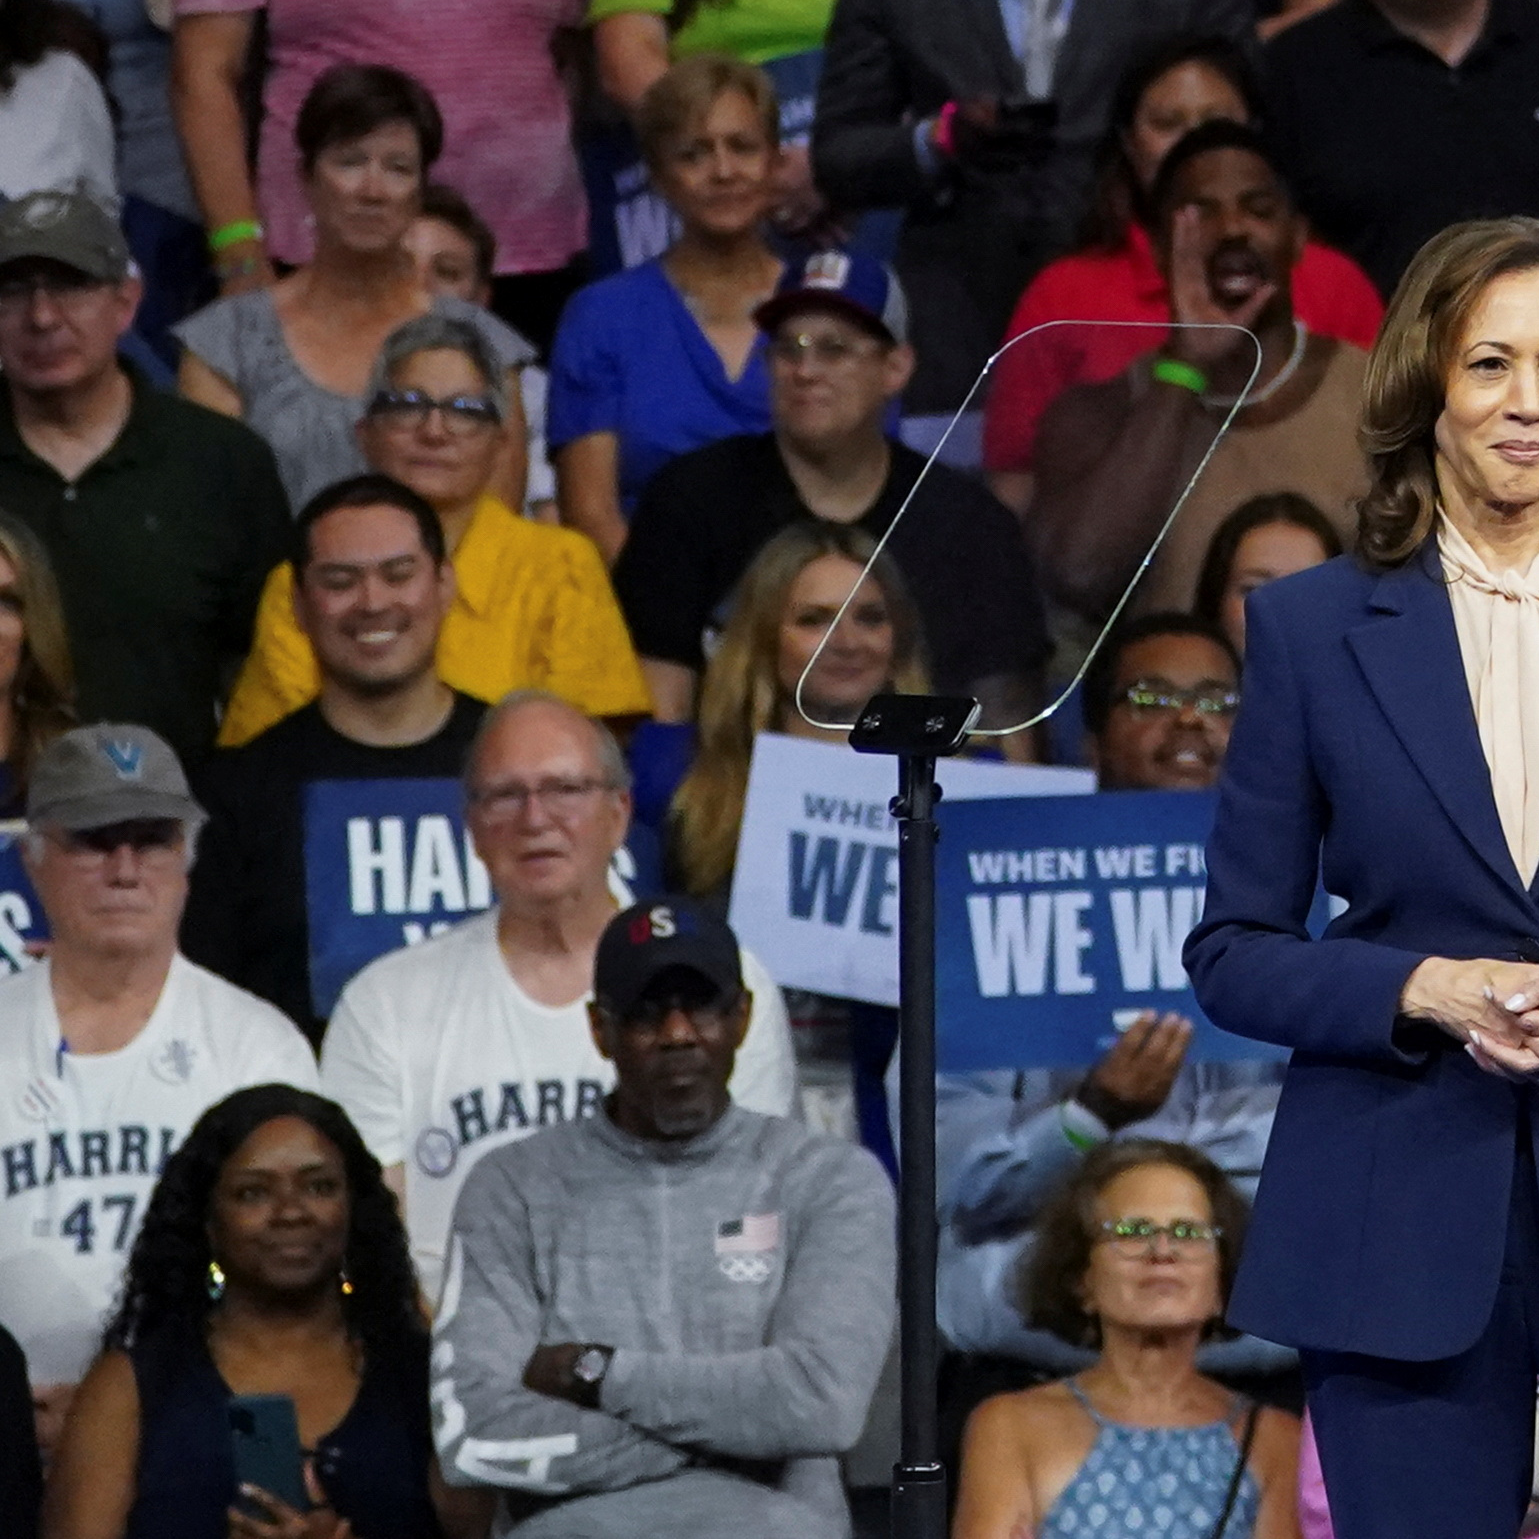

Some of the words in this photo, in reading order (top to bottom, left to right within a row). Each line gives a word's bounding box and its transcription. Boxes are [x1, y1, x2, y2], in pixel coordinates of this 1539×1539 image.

[788, 831, 899, 938] WE
[968, 847, 1087, 885] WHEN
[1093, 844, 1158, 879] WE
[1164, 841, 1206, 877] FI
[966, 888, 1096, 998] WE
[1109, 885, 1206, 991] W
[452, 1079, 603, 1147] HARR
[2, 1125, 176, 1200] HARRI
[60, 1193, 136, 1254] 47
